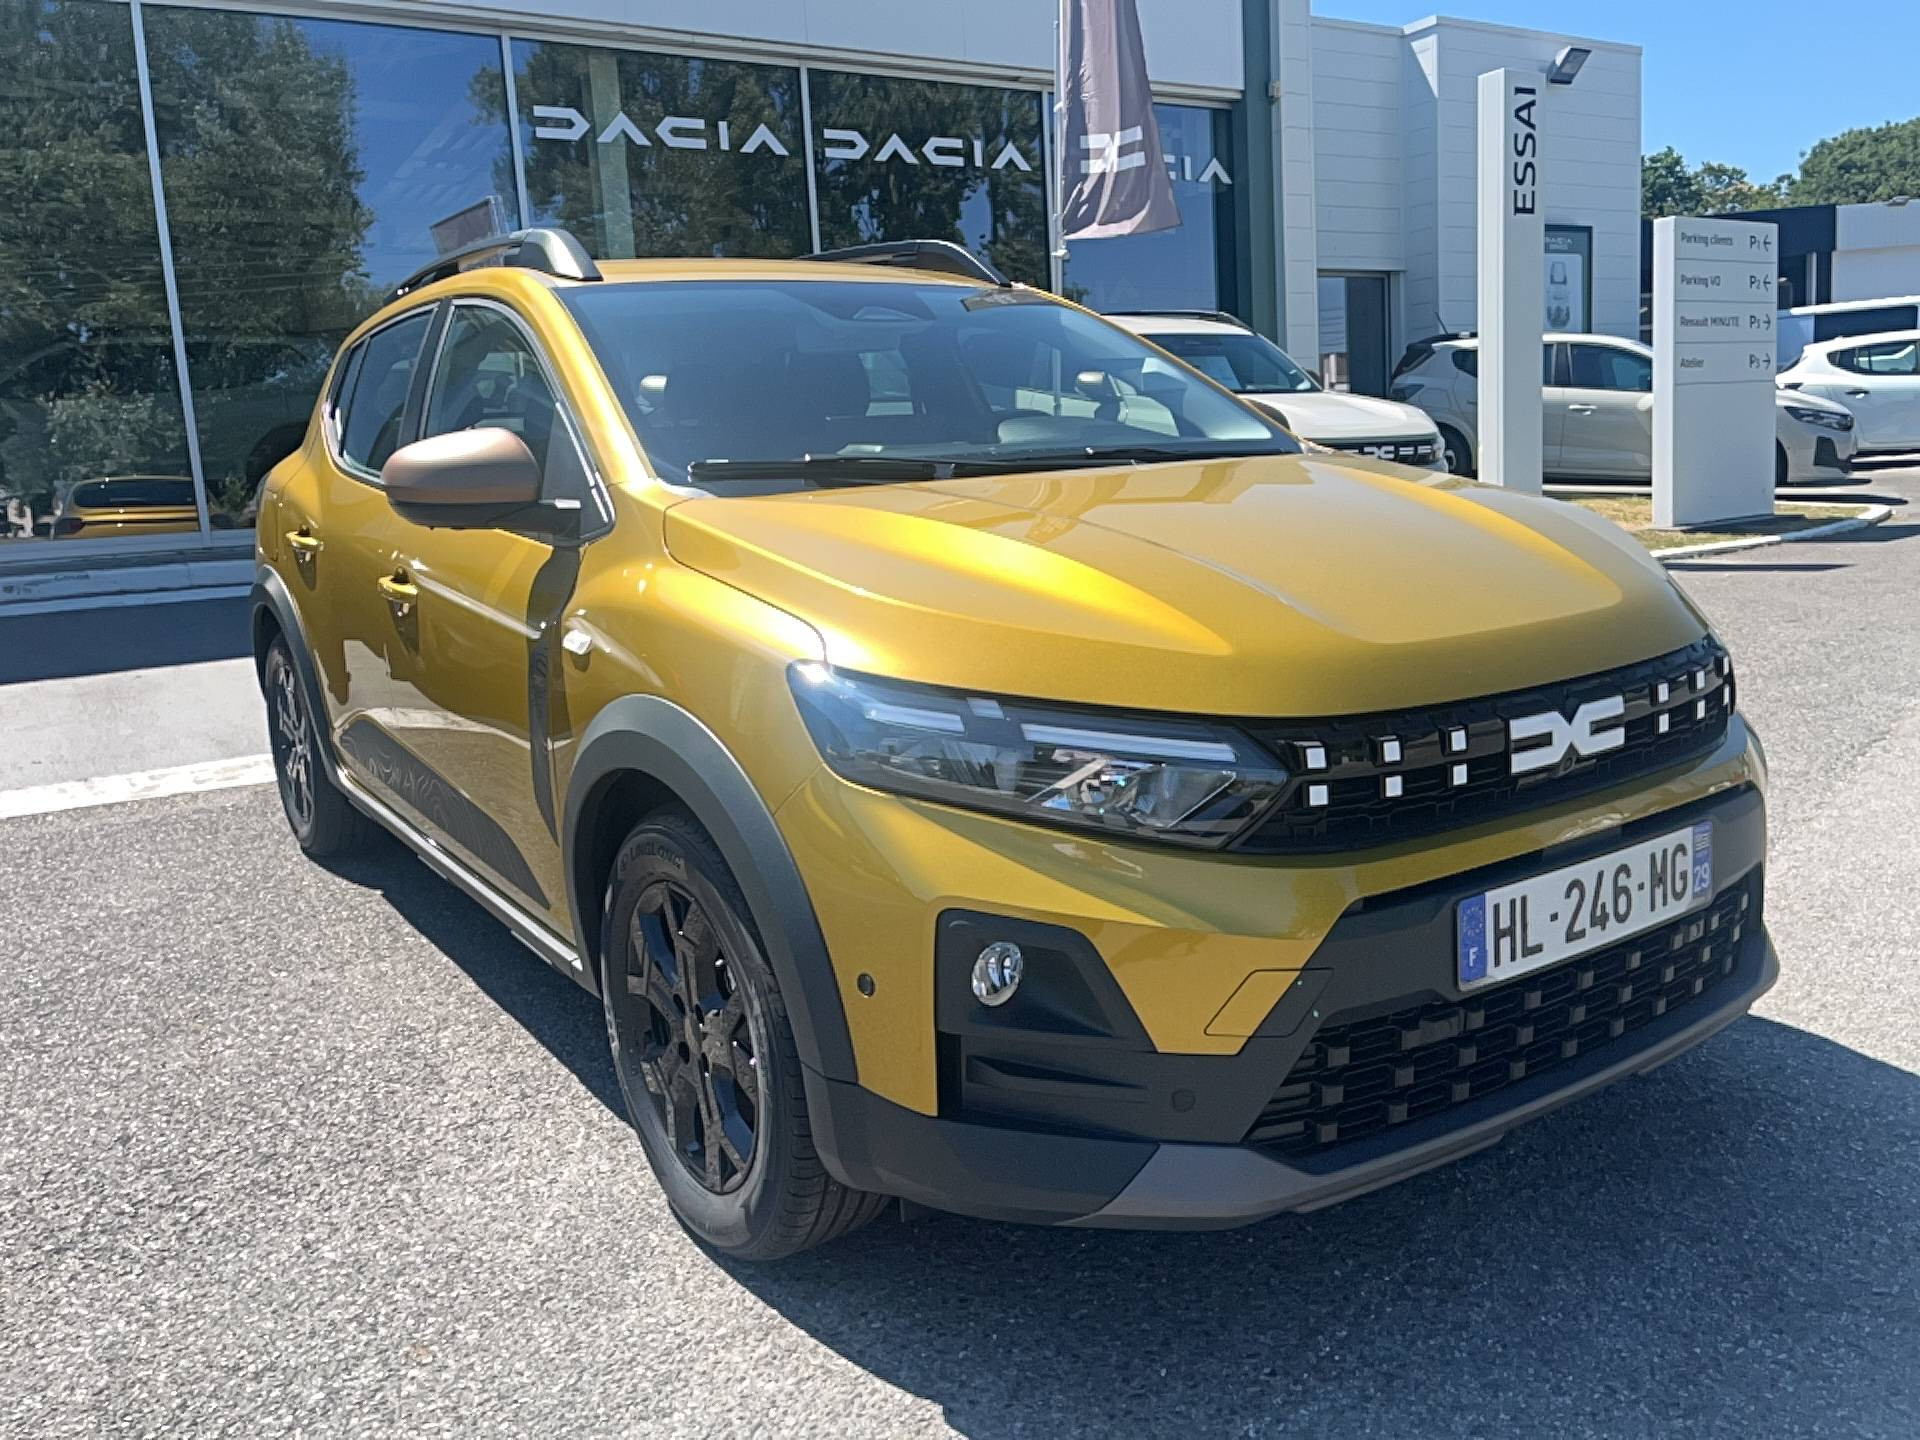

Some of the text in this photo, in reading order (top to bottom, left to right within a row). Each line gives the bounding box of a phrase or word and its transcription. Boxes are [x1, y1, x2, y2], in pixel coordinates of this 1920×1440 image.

[532, 105, 790, 156] DACIA
[823, 128, 1032, 172] DACIA
[1513, 86, 1536, 216] ESSAI
[1681, 232, 1709, 247] Parking
[1710, 234, 1733, 246] clients
[1681, 274, 1709, 288] Parking
[1680, 316, 1709, 328] Renault
[1710, 316, 1740, 328] MINUTE
[1680, 357, 1704, 369] Atelier
[1694, 863, 1710, 893] 29
[1492, 842, 1688, 968] HL-246-MG
[1468, 946, 1478, 967] F
